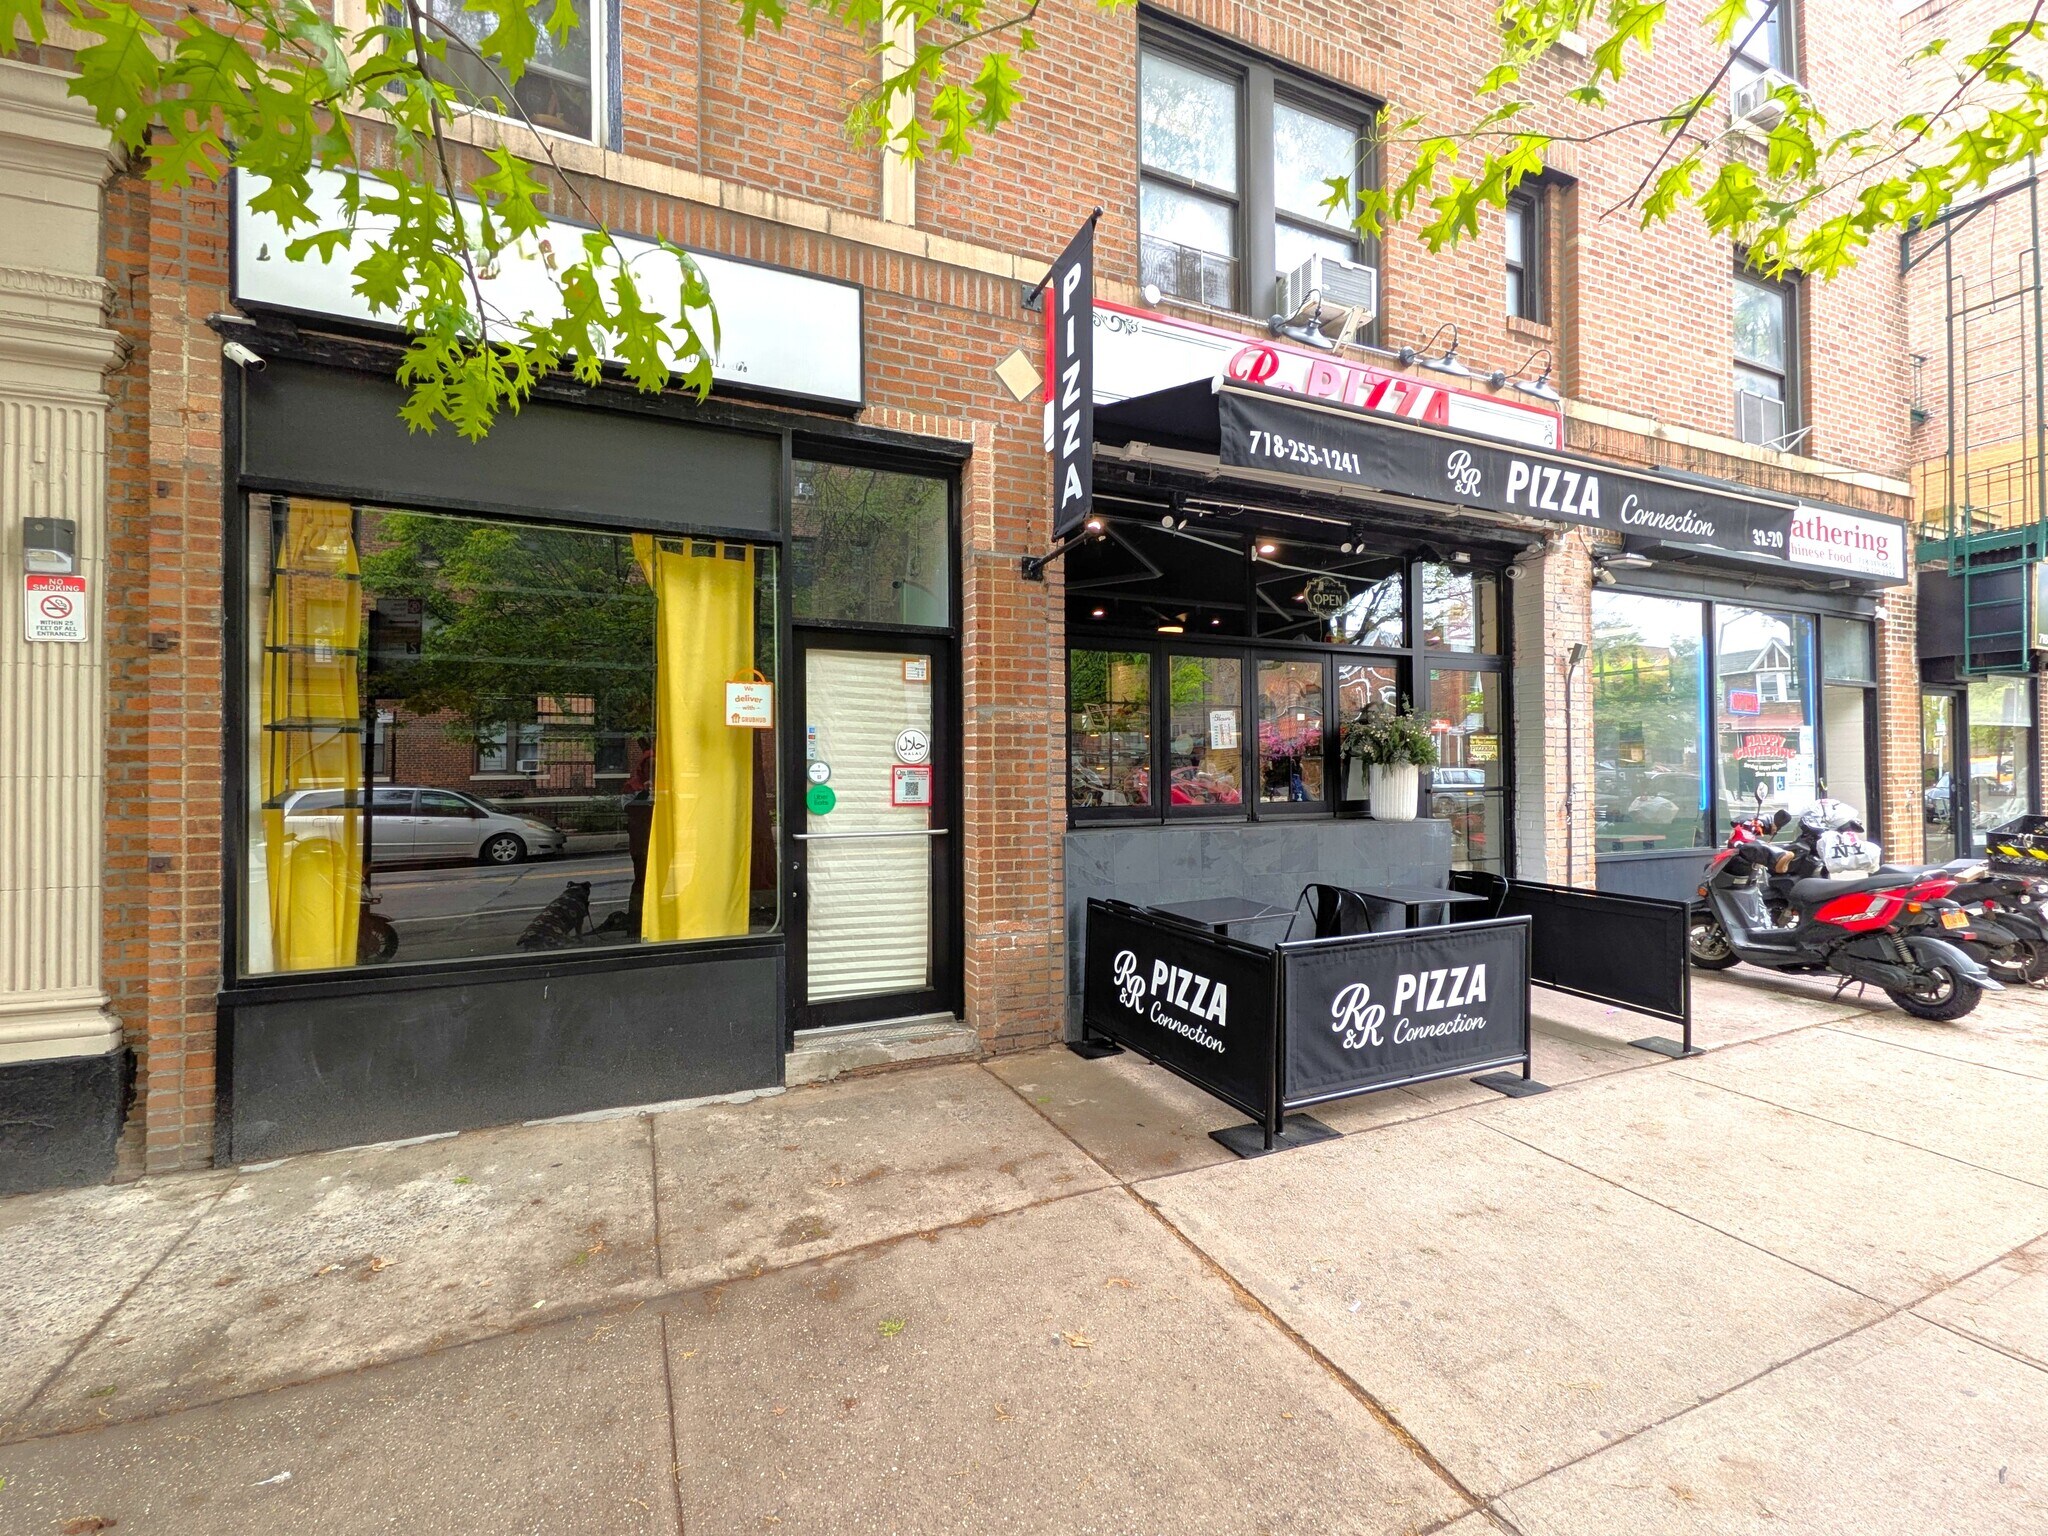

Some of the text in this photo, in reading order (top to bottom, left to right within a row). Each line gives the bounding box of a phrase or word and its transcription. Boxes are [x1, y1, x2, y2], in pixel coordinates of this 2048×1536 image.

[1062, 262, 1082, 510] PIZZA
[1306, 361, 1450, 426] PIZZA
[1249, 430, 1362, 475] 718-255-1241
[1505, 460, 1601, 519] PIZZA
[1620, 494, 1716, 538] Connection
[1752, 528, 1784, 549] 32-20
[1791, 516, 1889, 561] athering
[1791, 542, 1852, 563] hinese Food
[1313, 593, 1343, 606] OPEN
[735, 694, 763, 704] deliver
[1733, 746, 1797, 760] GATHERING
[1744, 733, 1787, 747] HAPPY
[1831, 842, 1865, 859] NY
[1150, 958, 1228, 1027] PIZZA
[1392, 963, 1487, 1016] PIZZA
[1150, 1000, 1226, 1054] Connection
[1393, 1012, 1487, 1045] Connection
